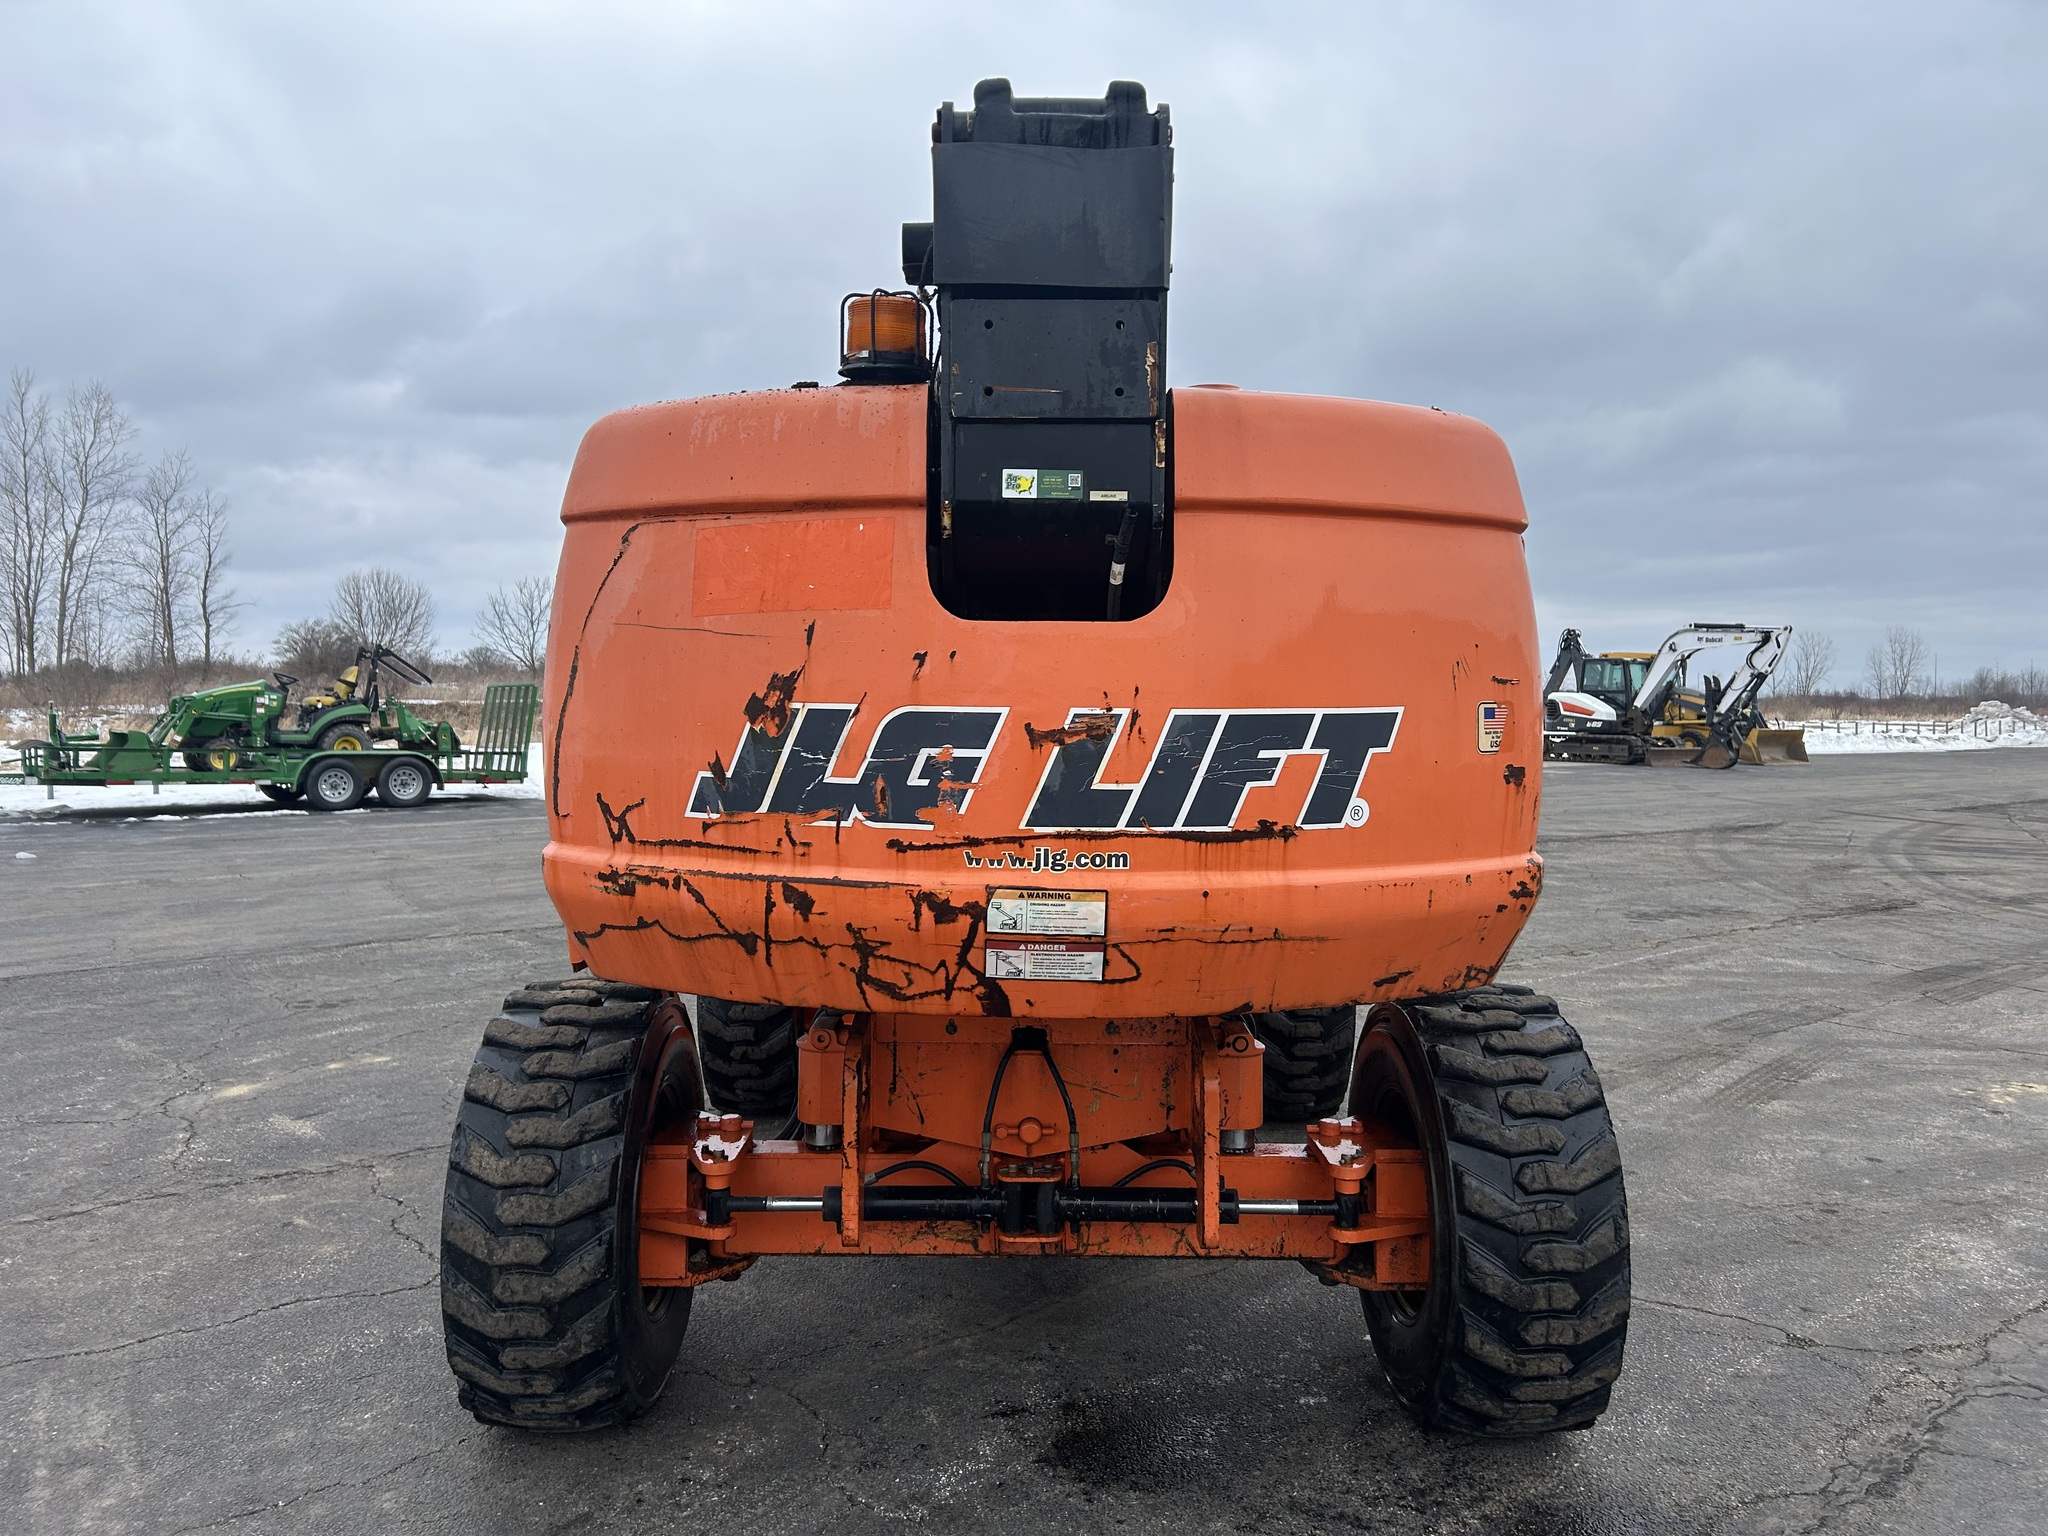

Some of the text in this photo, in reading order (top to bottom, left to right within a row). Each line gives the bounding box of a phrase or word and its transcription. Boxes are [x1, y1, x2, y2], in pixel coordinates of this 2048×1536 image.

[1004, 482, 1020, 490] Pro
[684, 702, 1010, 830] JLG
[1026, 891, 1071, 900] WARNING
[1027, 943, 1067, 951] DANGER
